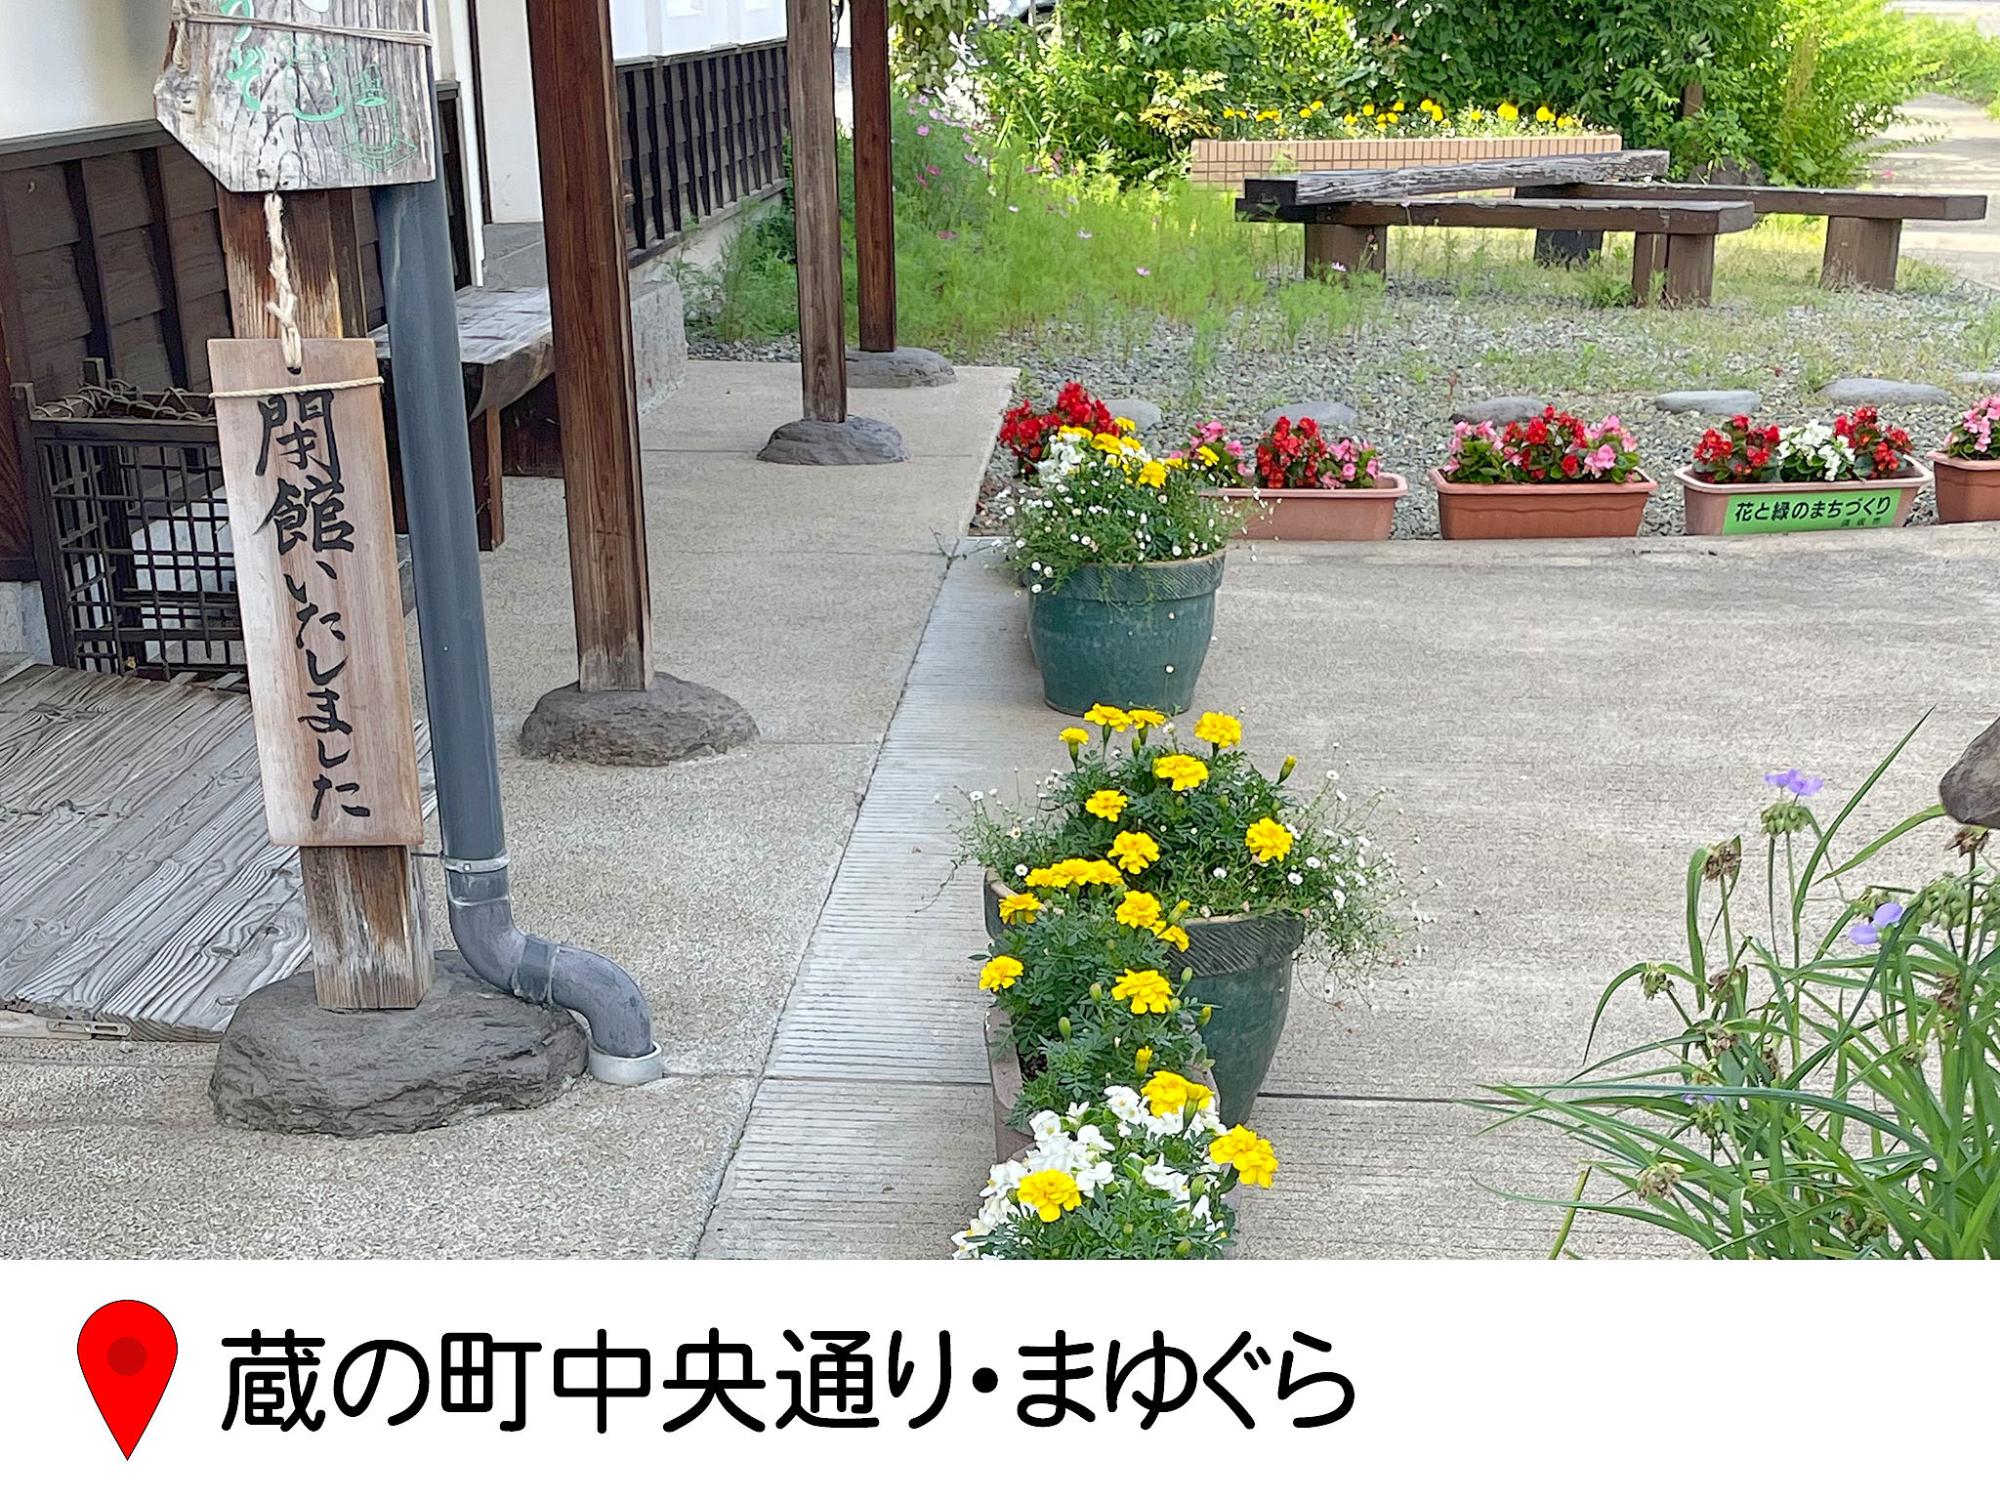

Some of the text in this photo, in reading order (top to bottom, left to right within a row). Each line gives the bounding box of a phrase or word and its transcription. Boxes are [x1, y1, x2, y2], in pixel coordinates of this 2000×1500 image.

[253, 390, 371, 822] 閉館いたしました
[1735, 496, 1891, 523] 花と緑のまちづくり
